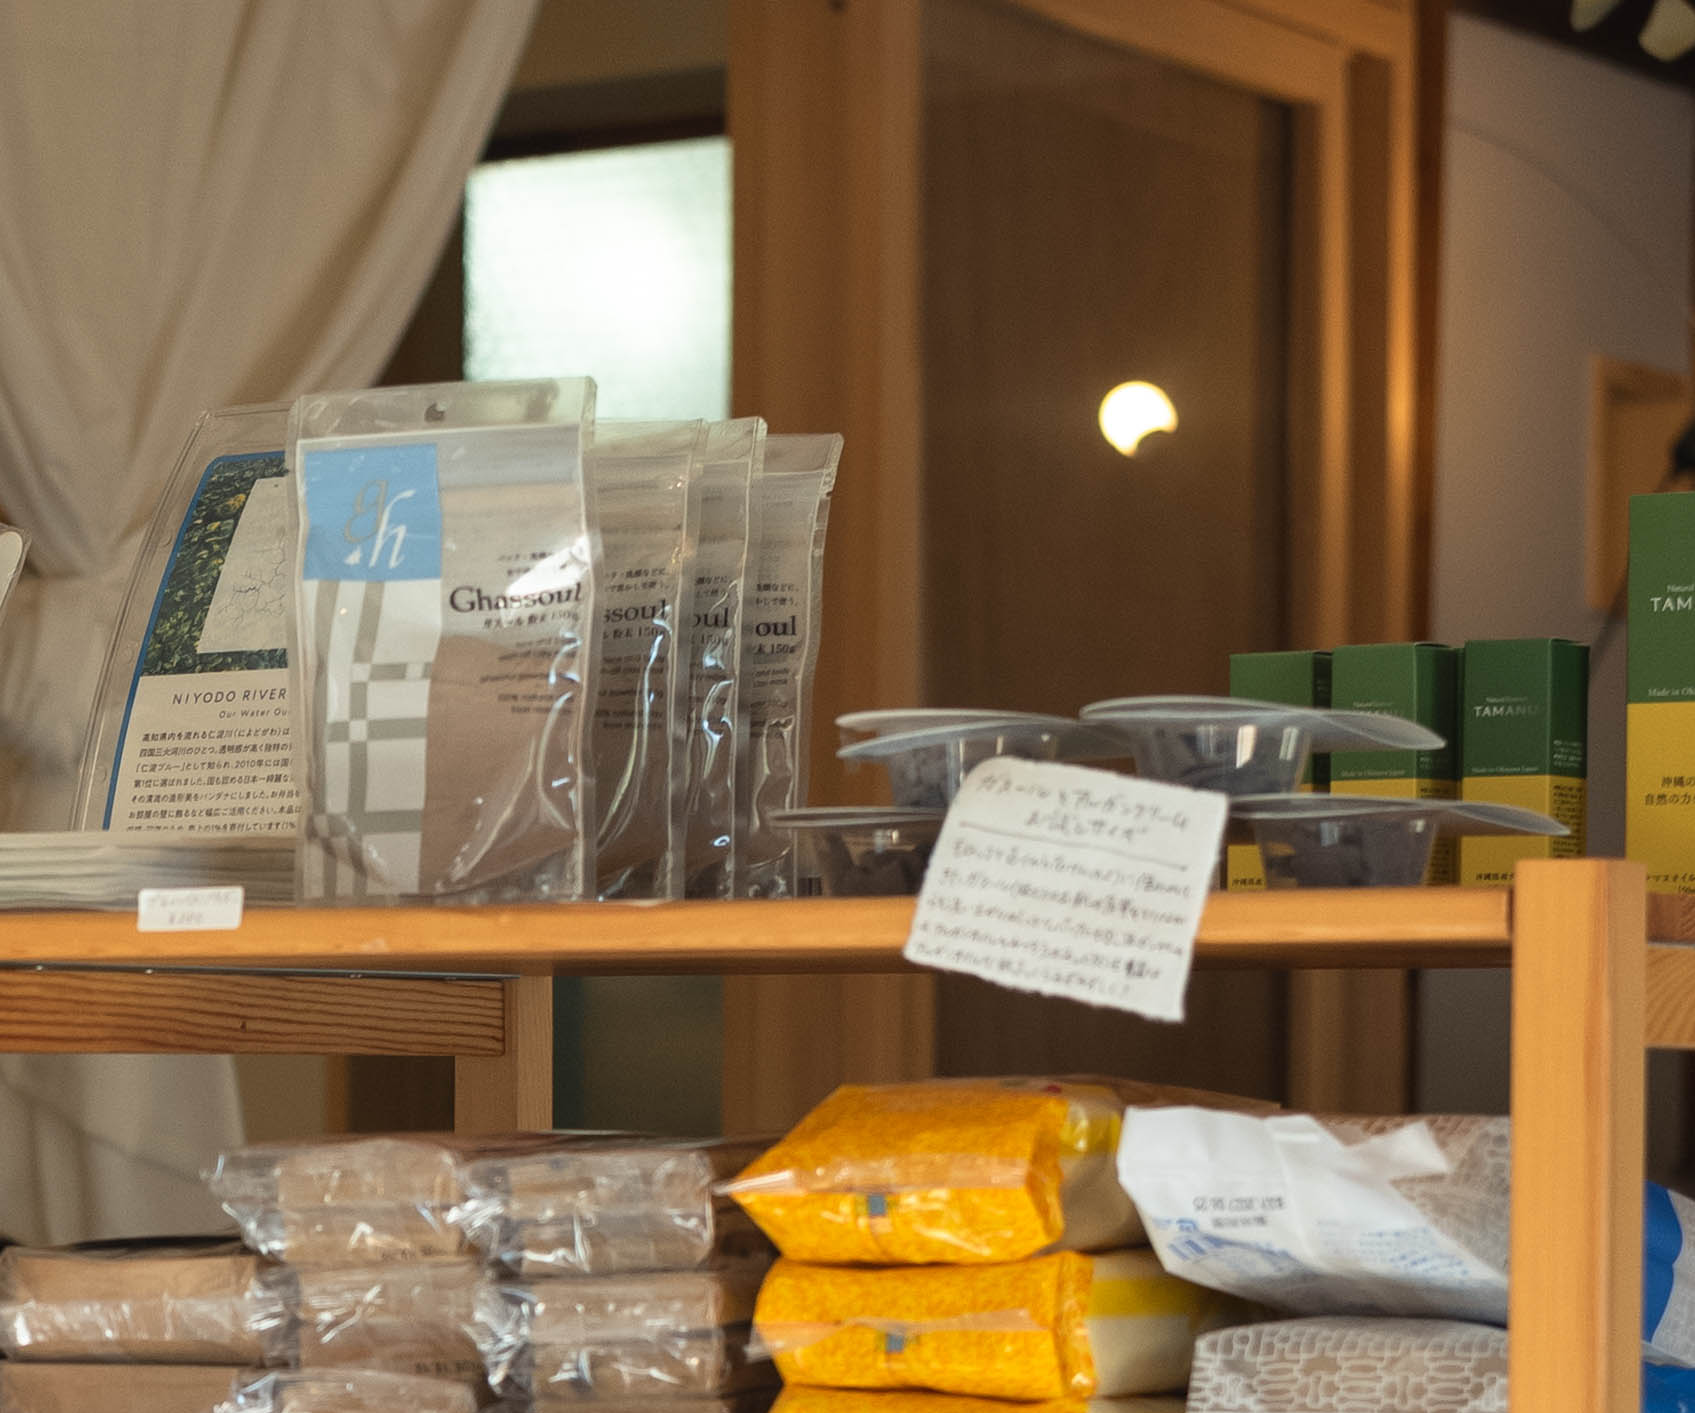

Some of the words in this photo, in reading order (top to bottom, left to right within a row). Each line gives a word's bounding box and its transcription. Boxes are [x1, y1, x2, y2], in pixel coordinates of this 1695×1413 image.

[449, 582, 582, 614] Ghassoul
[172, 690, 237, 705] NIYODO
[242, 687, 288, 702] RIVER
[219, 709, 237, 719] Our
[241, 708, 270, 718] Water
